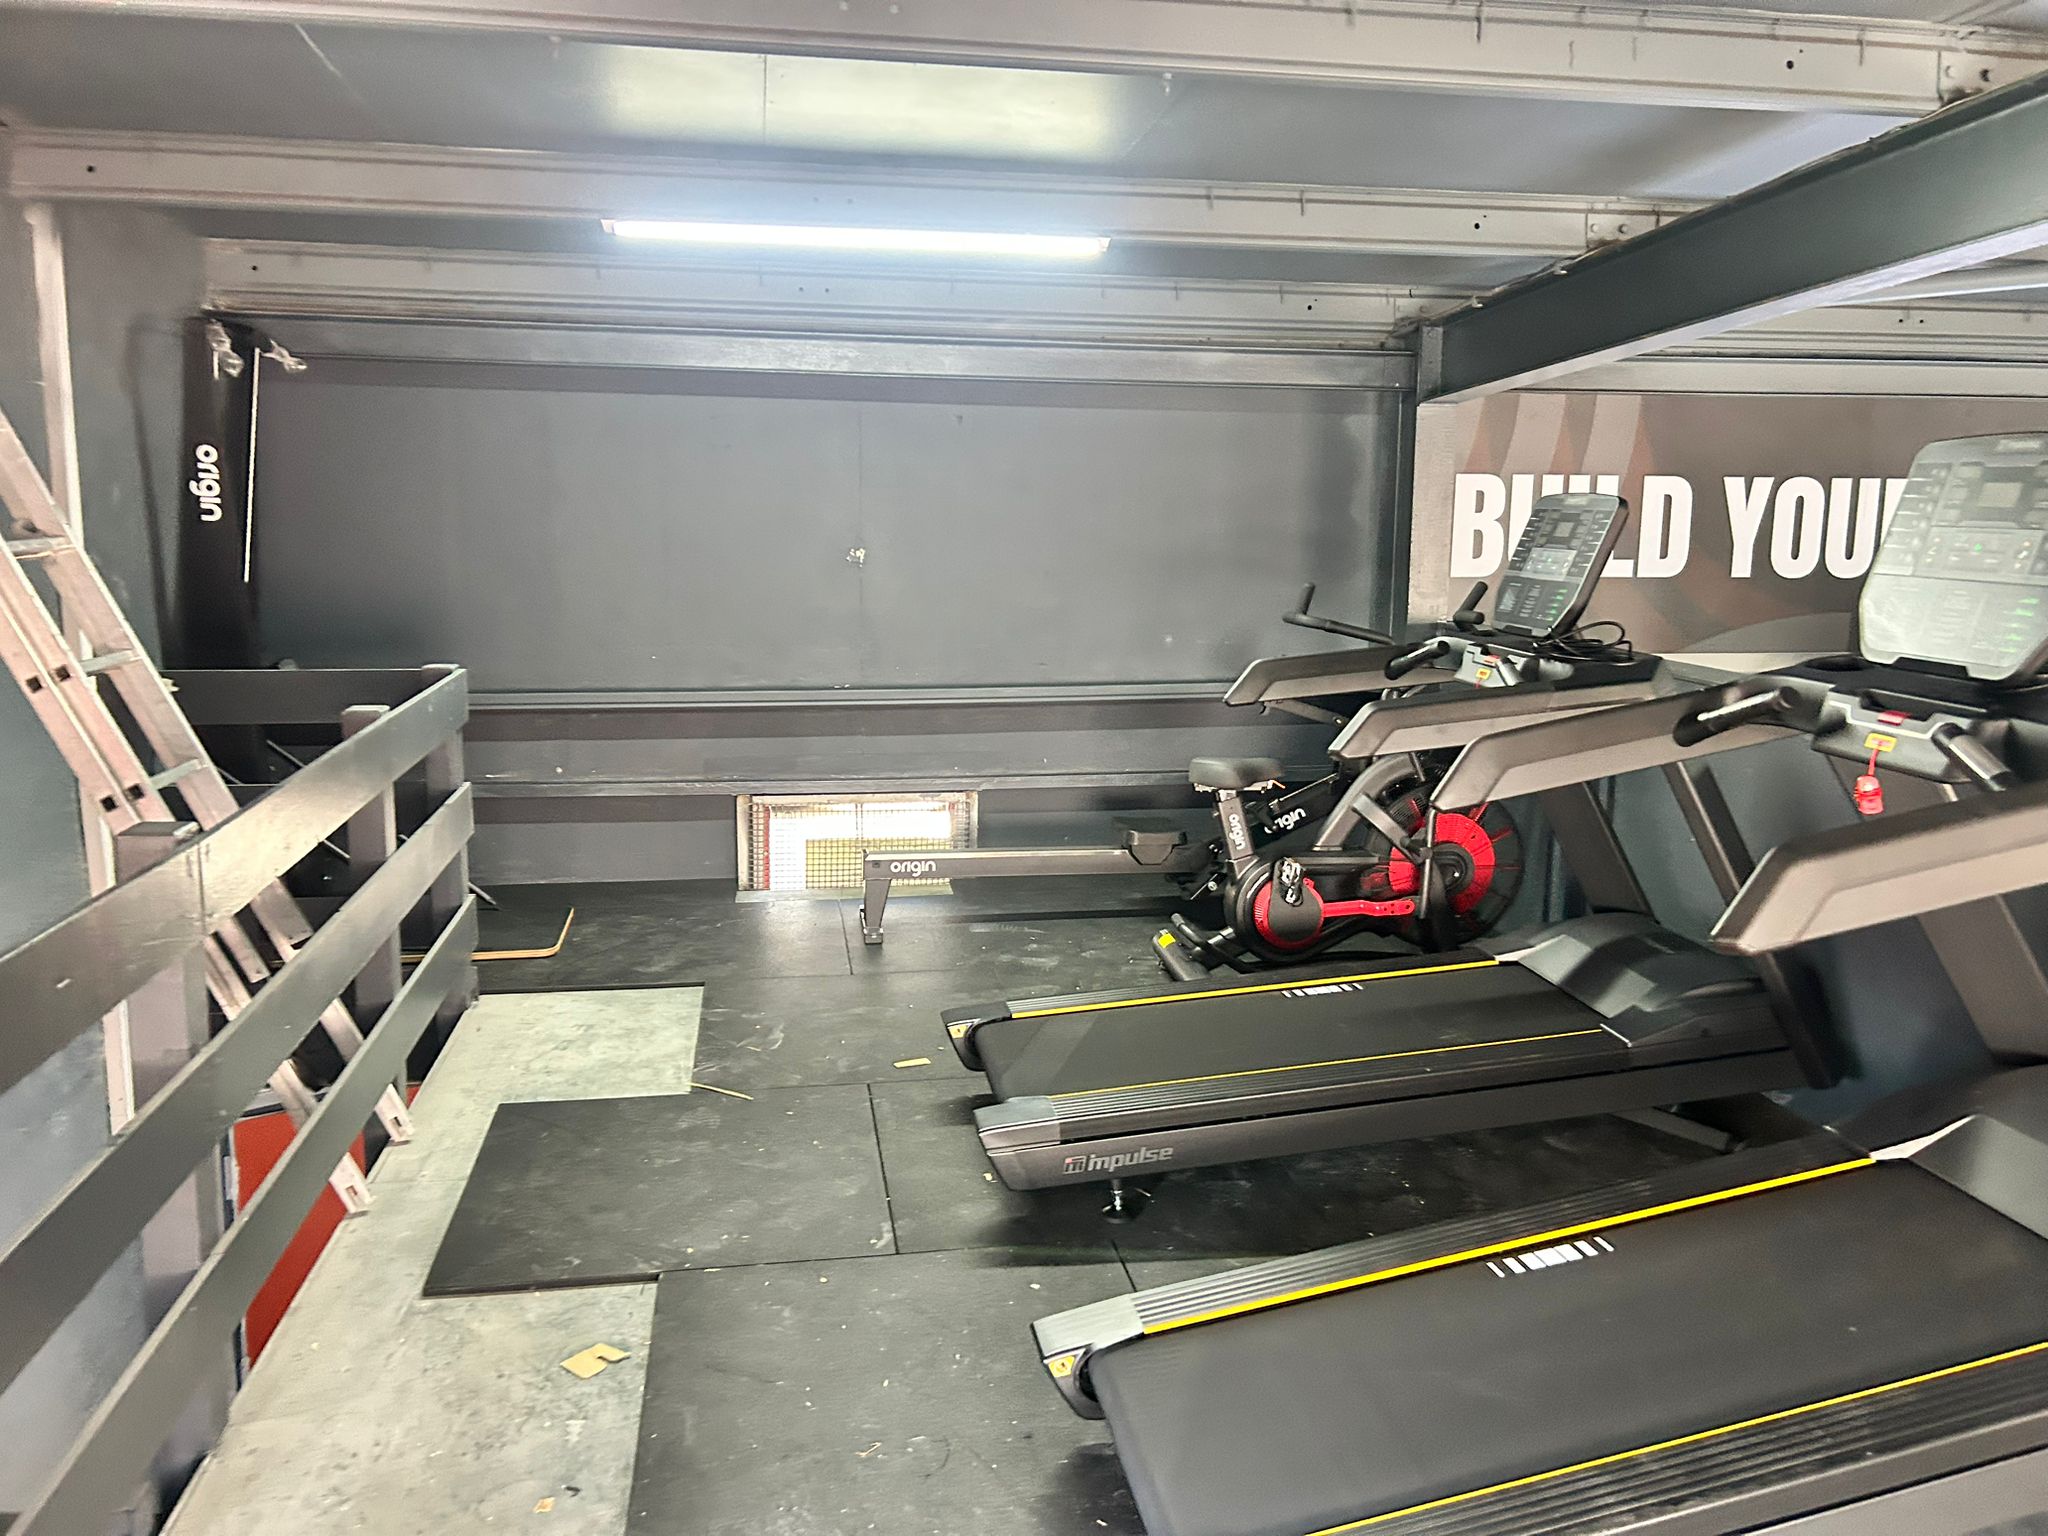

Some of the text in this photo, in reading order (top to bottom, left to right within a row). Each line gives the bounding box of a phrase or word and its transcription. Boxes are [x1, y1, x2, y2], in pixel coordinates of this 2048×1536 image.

[188, 444, 223, 522] origin
[1450, 472, 1694, 580] BUD
[1229, 813, 1246, 850] origin
[1264, 807, 1307, 834] igin
[890, 860, 937, 877] origin
[1087, 1147, 1174, 1172] impulse
